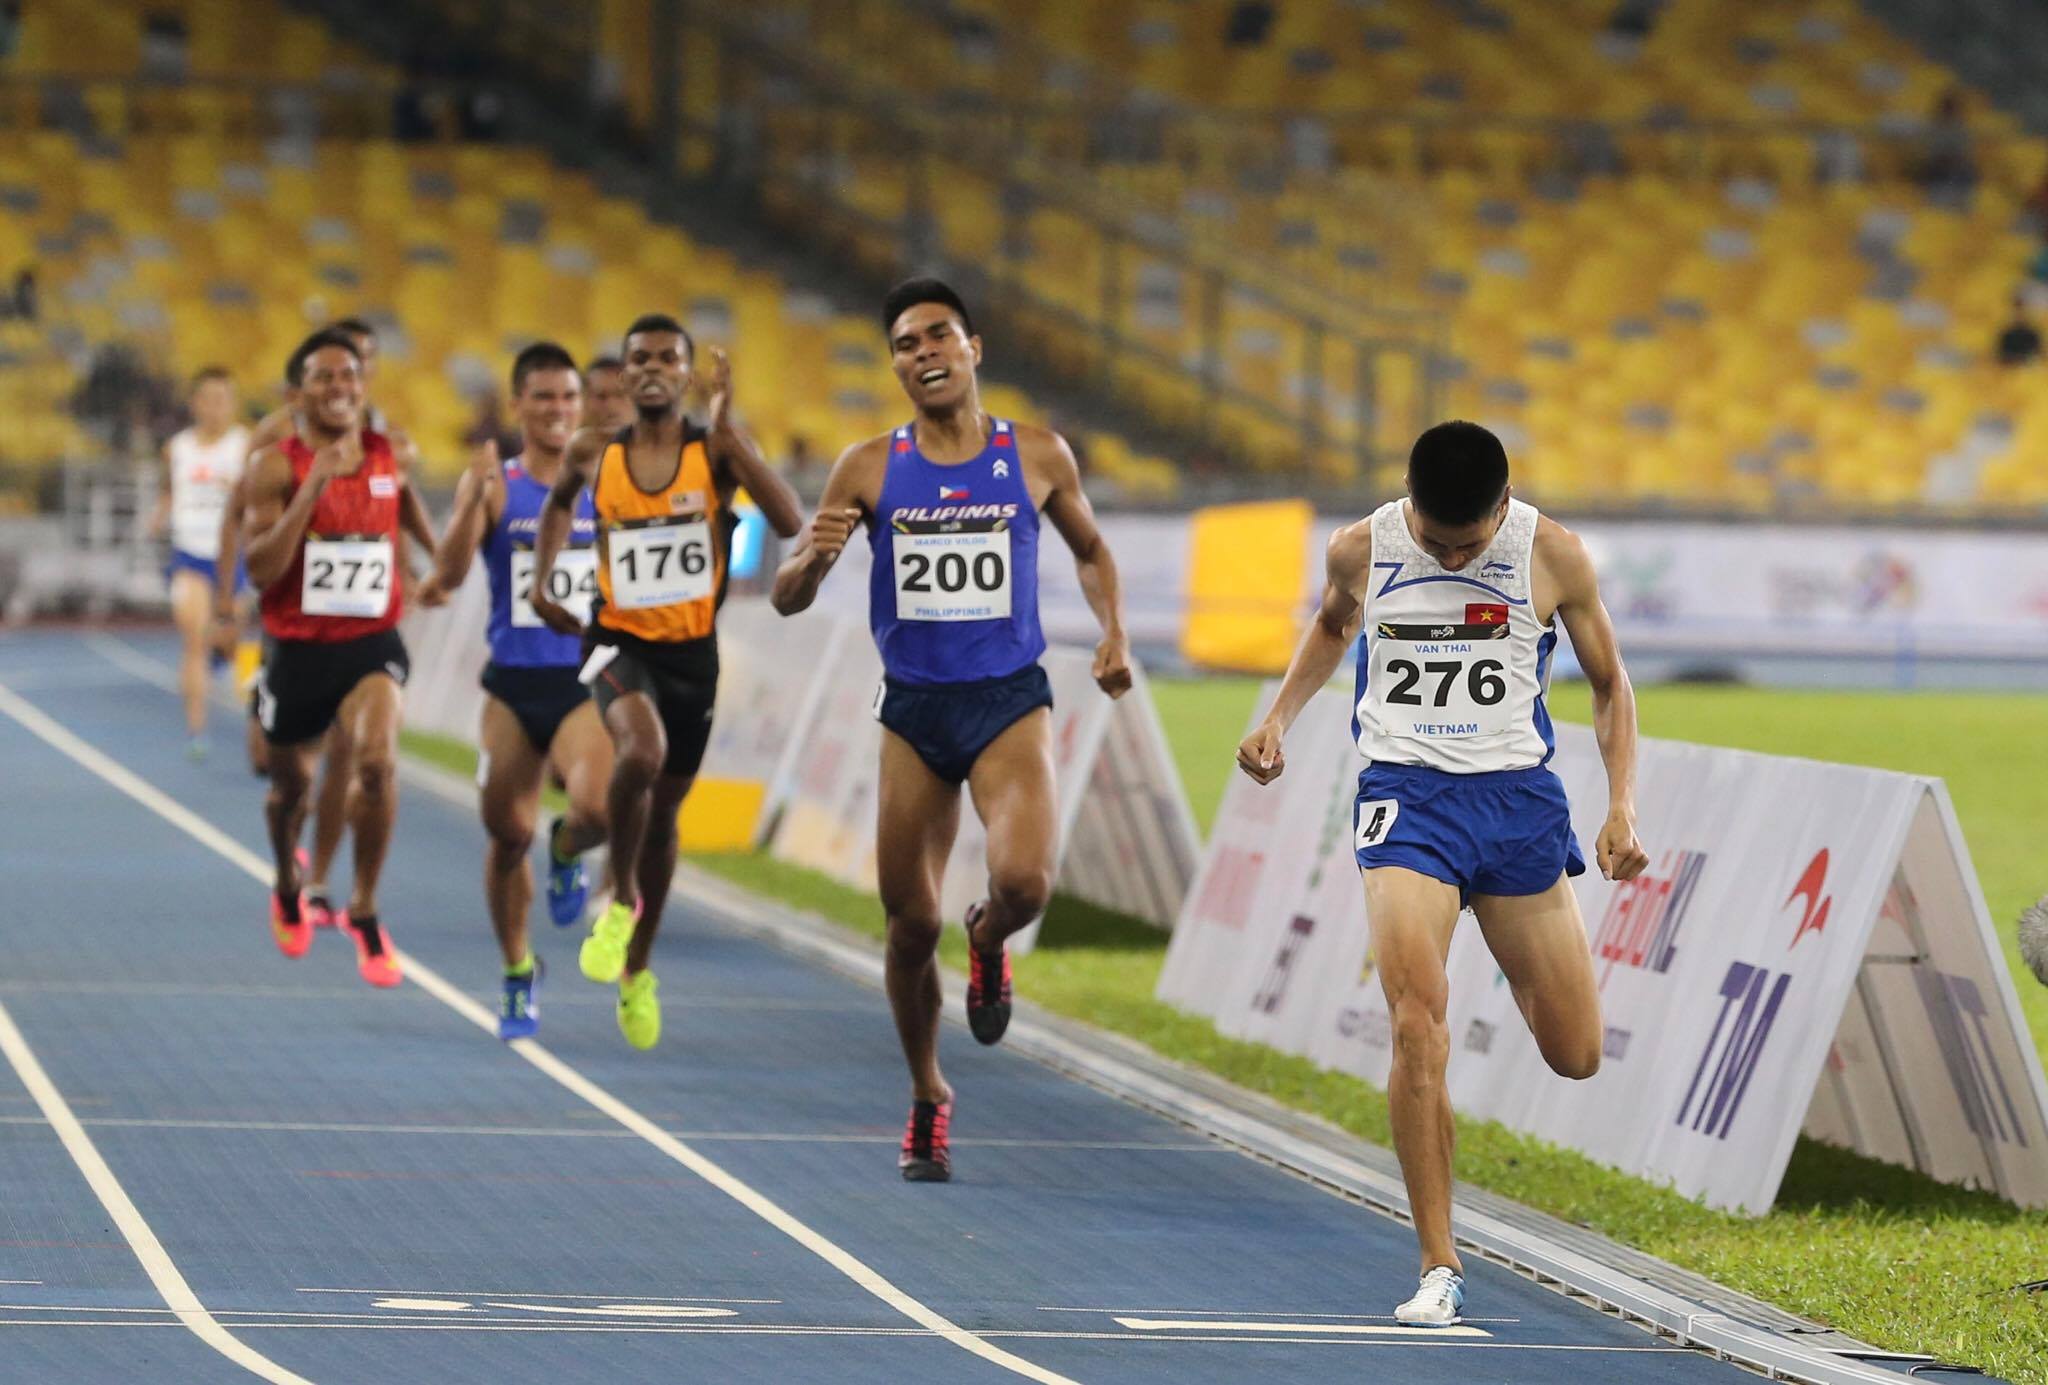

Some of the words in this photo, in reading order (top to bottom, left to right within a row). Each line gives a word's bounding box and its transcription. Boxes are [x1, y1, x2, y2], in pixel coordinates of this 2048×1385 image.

[891, 504, 1018, 521] PILIPINAS
[311, 559, 386, 591] 272
[617, 541, 706, 582] 176
[900, 552, 1004, 592] 200
[915, 607, 992, 617] PHILIPPINES
[1414, 644, 1439, 653] VAN
[1443, 644, 1471, 653] THAI
[1386, 659, 1506, 707] 276
[1413, 724, 1478, 735] VIETNAM
[1362, 806, 1386, 842] 4
[1675, 961, 1792, 1140] TM
